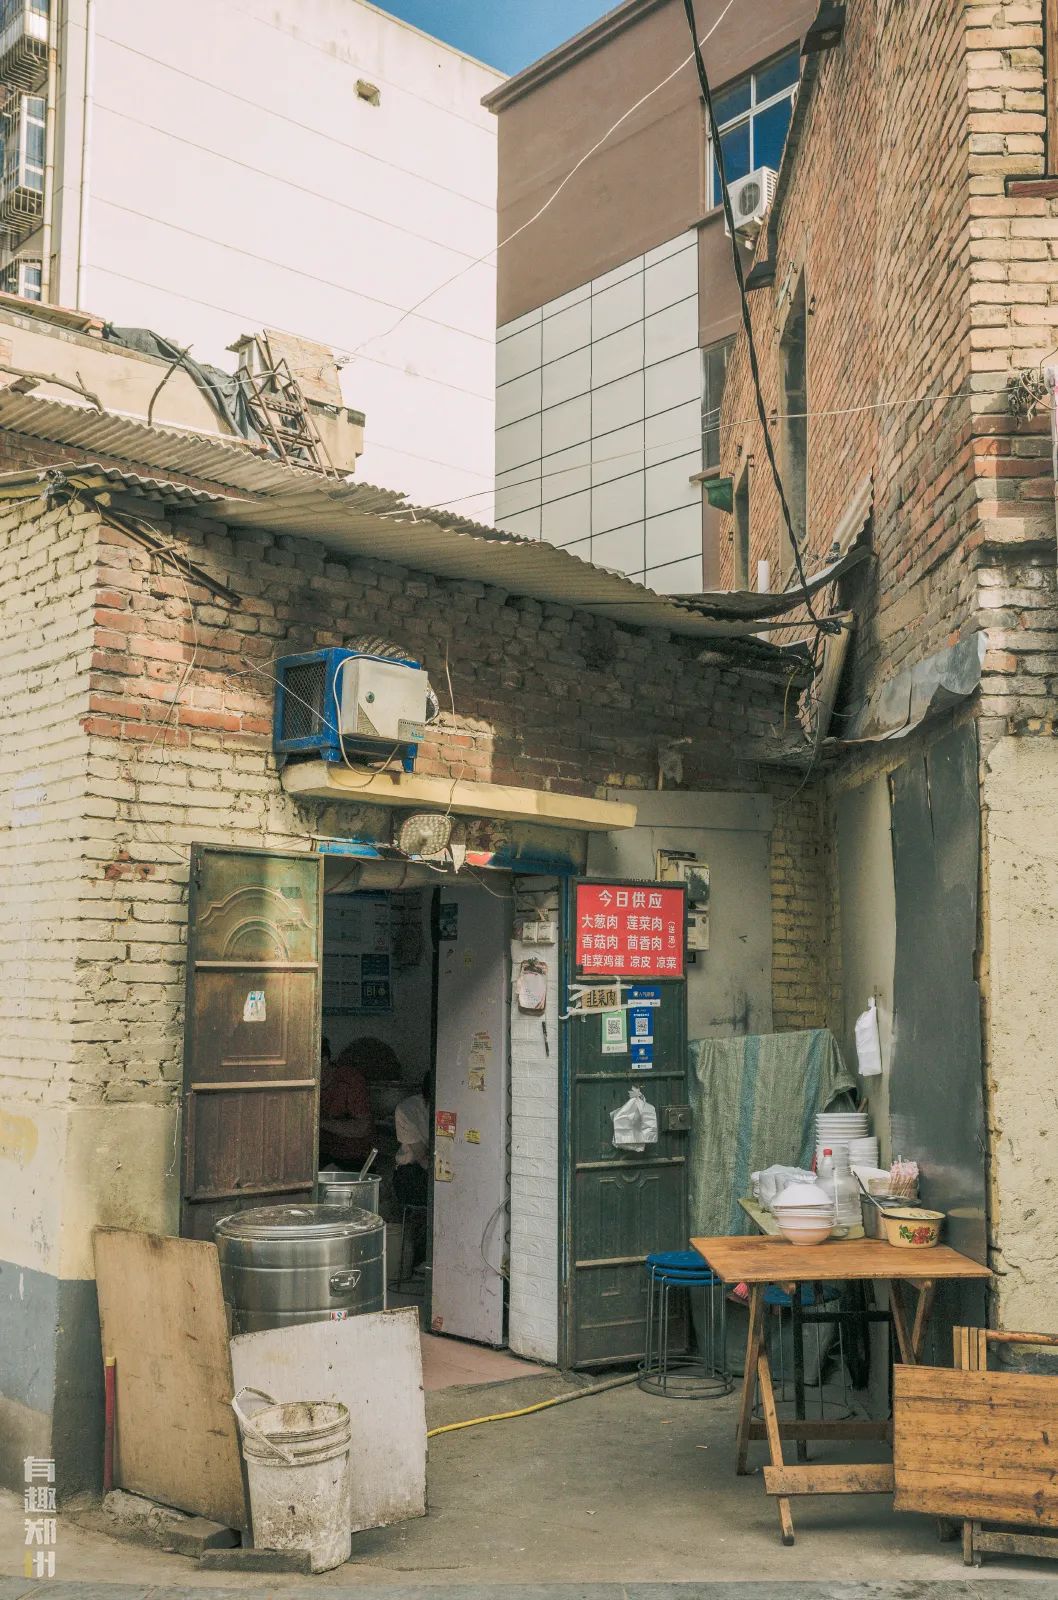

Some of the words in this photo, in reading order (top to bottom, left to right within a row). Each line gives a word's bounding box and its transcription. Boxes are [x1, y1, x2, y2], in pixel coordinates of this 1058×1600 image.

[598, 890, 663, 909] 今日供应
[581, 914, 618, 930] 大葱肉
[626, 915, 663, 931] 莲菜肉
[581, 934, 618, 950] 香菇肉
[627, 935, 662, 951] 茴香肉
[581, 954, 625, 968] 韭菜鸡蛋
[630, 956, 651, 969] 凉皮
[656, 956, 677, 969] 凉菜
[586, 989, 616, 1008] 韭菜肉
